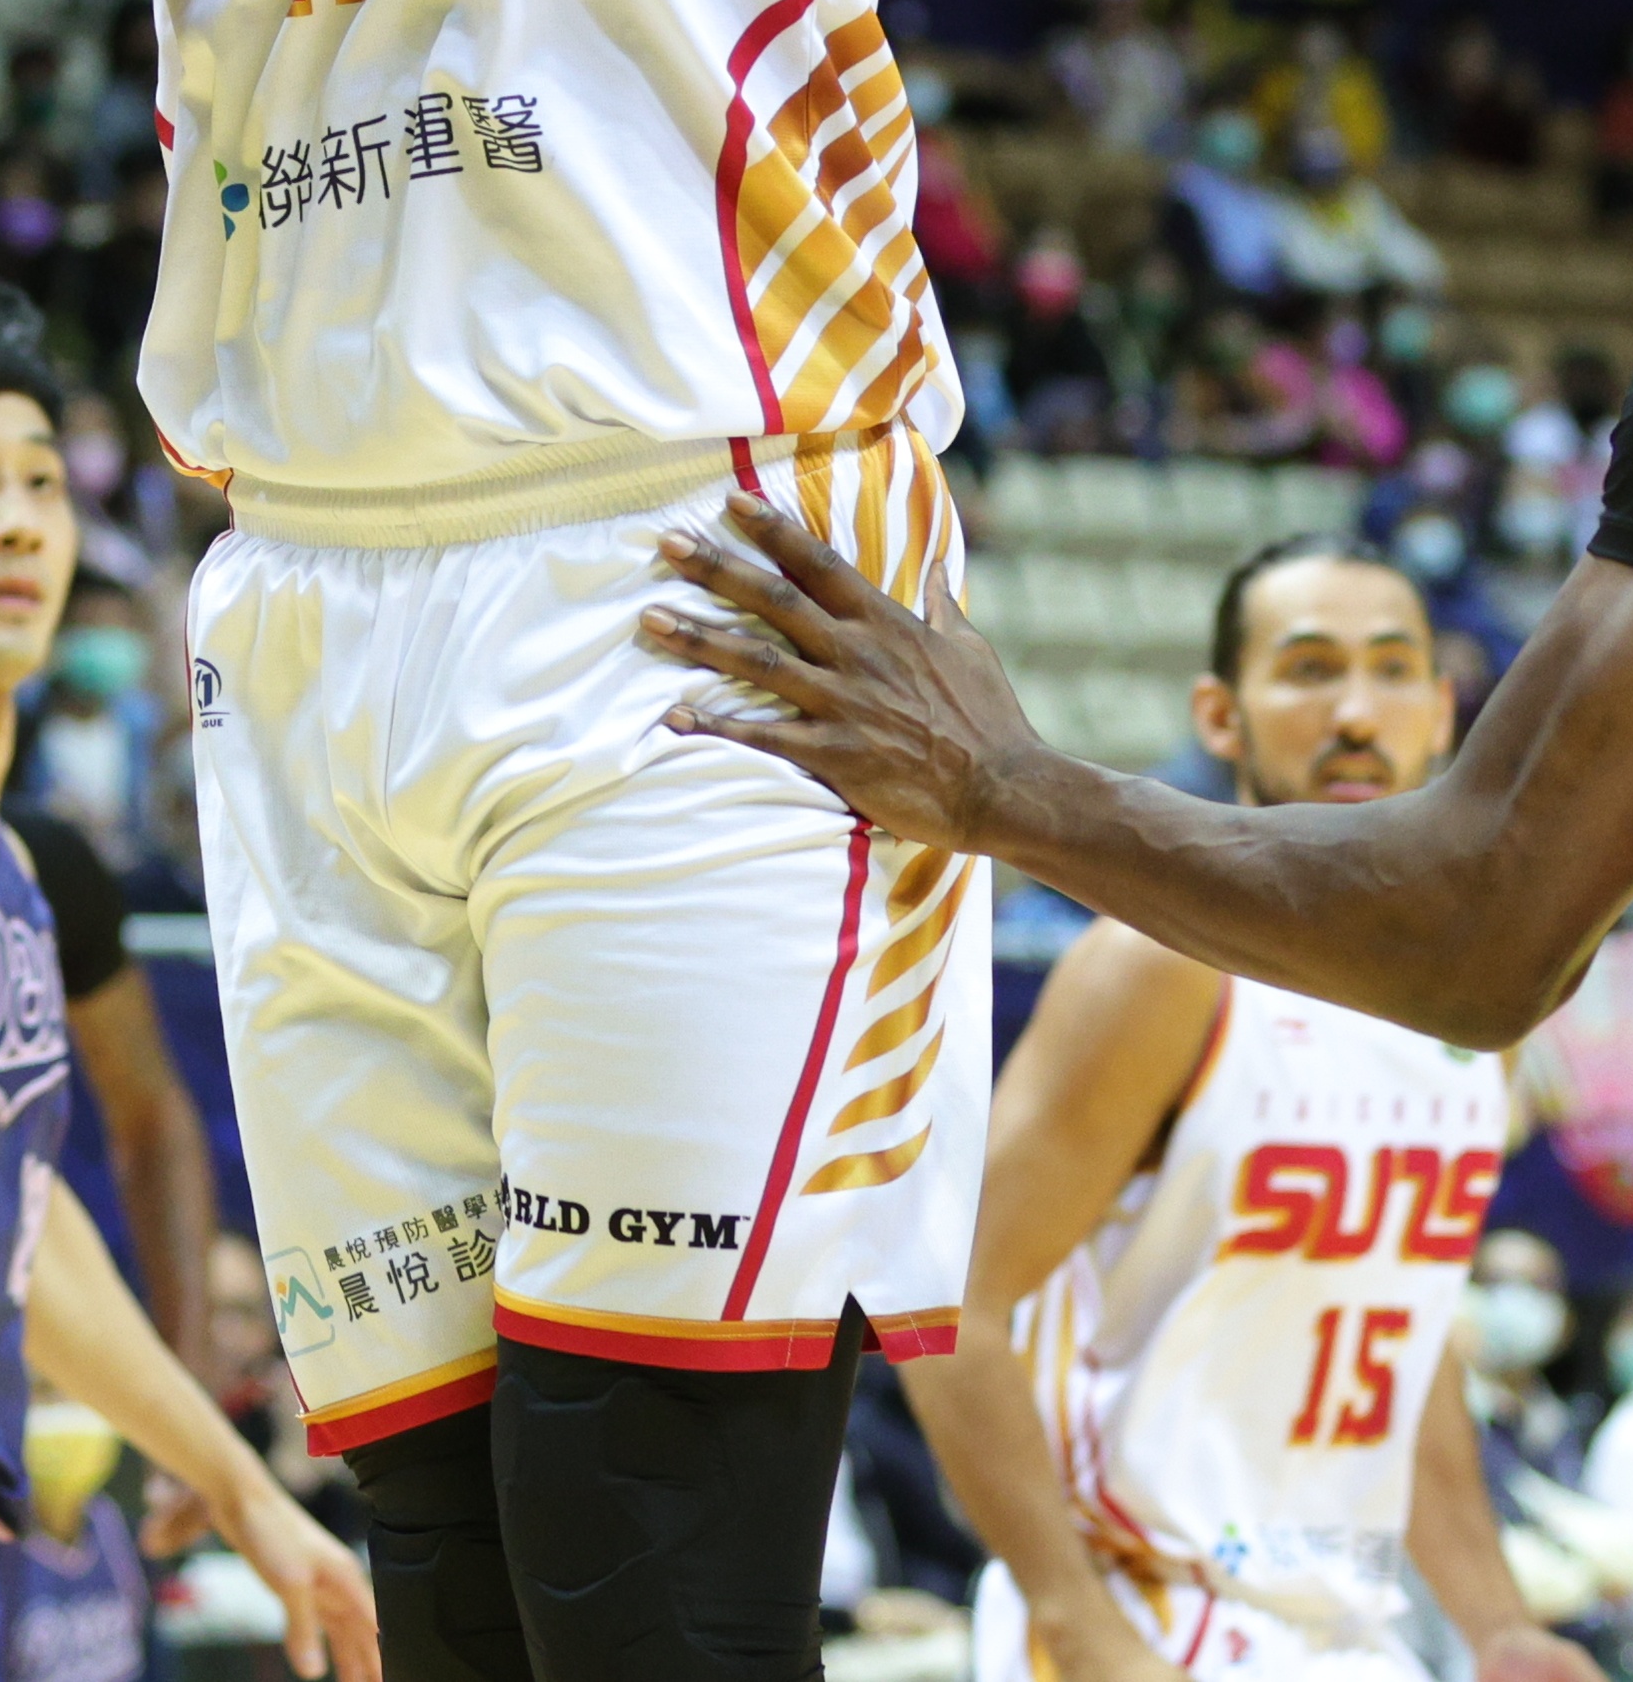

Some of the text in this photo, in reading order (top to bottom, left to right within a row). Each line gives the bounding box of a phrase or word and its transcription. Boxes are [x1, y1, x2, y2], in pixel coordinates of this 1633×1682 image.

[608, 1207, 740, 1250] GYM
[1216, 1142, 1504, 1263] SUNS
[337, 1228, 497, 1323] 晨悅診
[1287, 1306, 1411, 1450] 15
